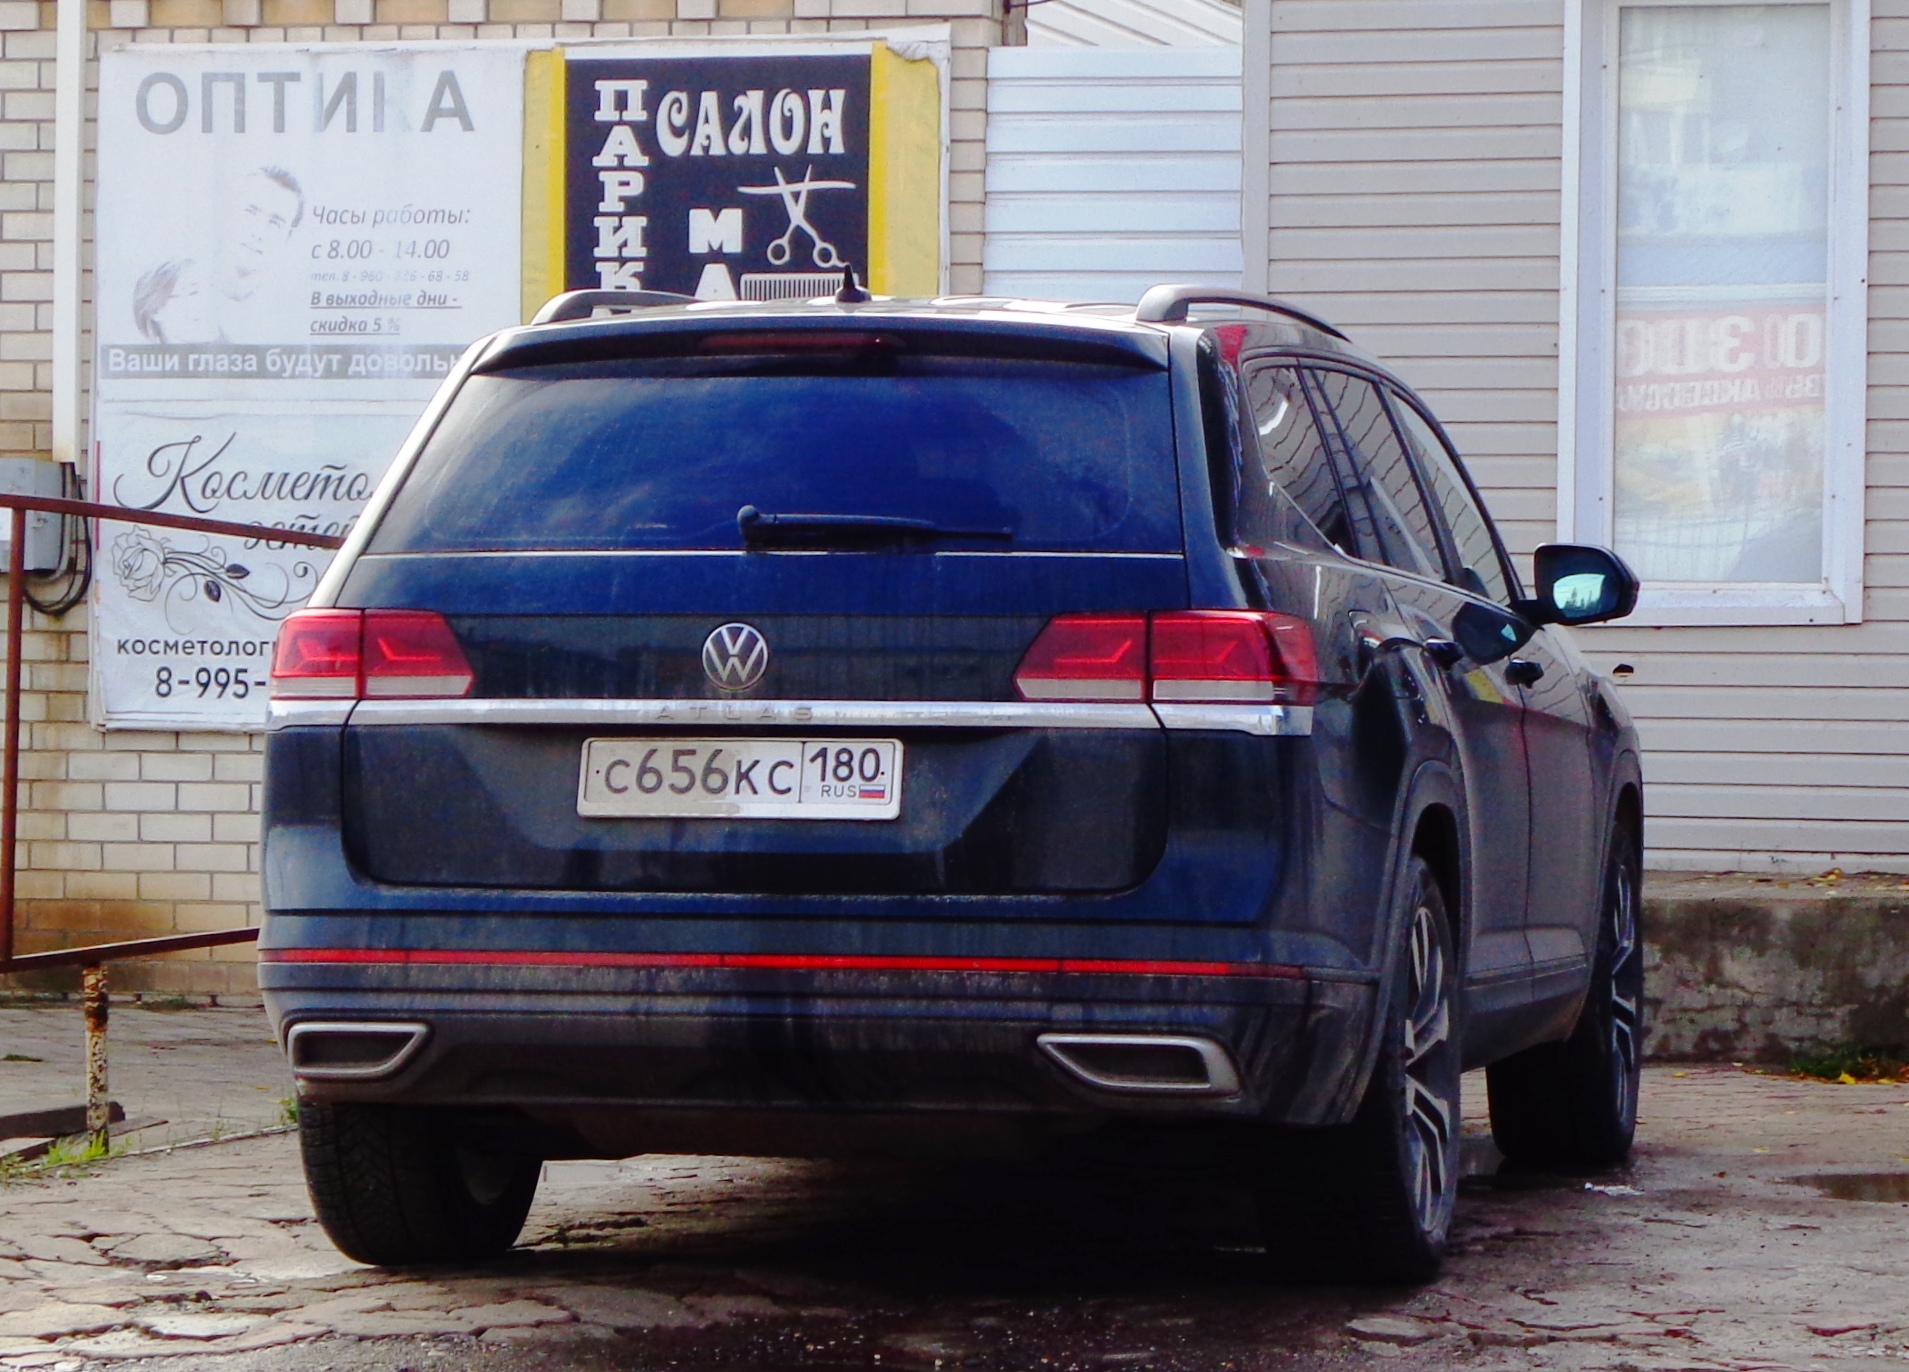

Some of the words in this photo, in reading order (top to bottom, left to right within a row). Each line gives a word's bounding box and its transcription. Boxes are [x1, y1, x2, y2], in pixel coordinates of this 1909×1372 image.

[655, 88, 847, 157] САЛОН
[592, 80, 649, 318] ПАРИК
[313, 205, 366, 225] Часы
[372, 203, 471, 229] работы:
[327, 239, 372, 259] 8.00
[393, 239, 450, 259] 14.00
[325, 289, 412, 307] выходные
[416, 289, 447, 306] дни
[310, 315, 368, 333] скидка
[372, 317, 382, 332] 5
[108, 348, 180, 372] Ваши
[188, 354, 257, 372] глаза
[265, 347, 342, 377] будут
[113, 431, 374, 514] Космето
[117, 639, 277, 657] косметолог
[655, 705, 814, 721] ATLAS
[808, 746, 882, 783] 180
[820, 784, 857, 798] RUS
